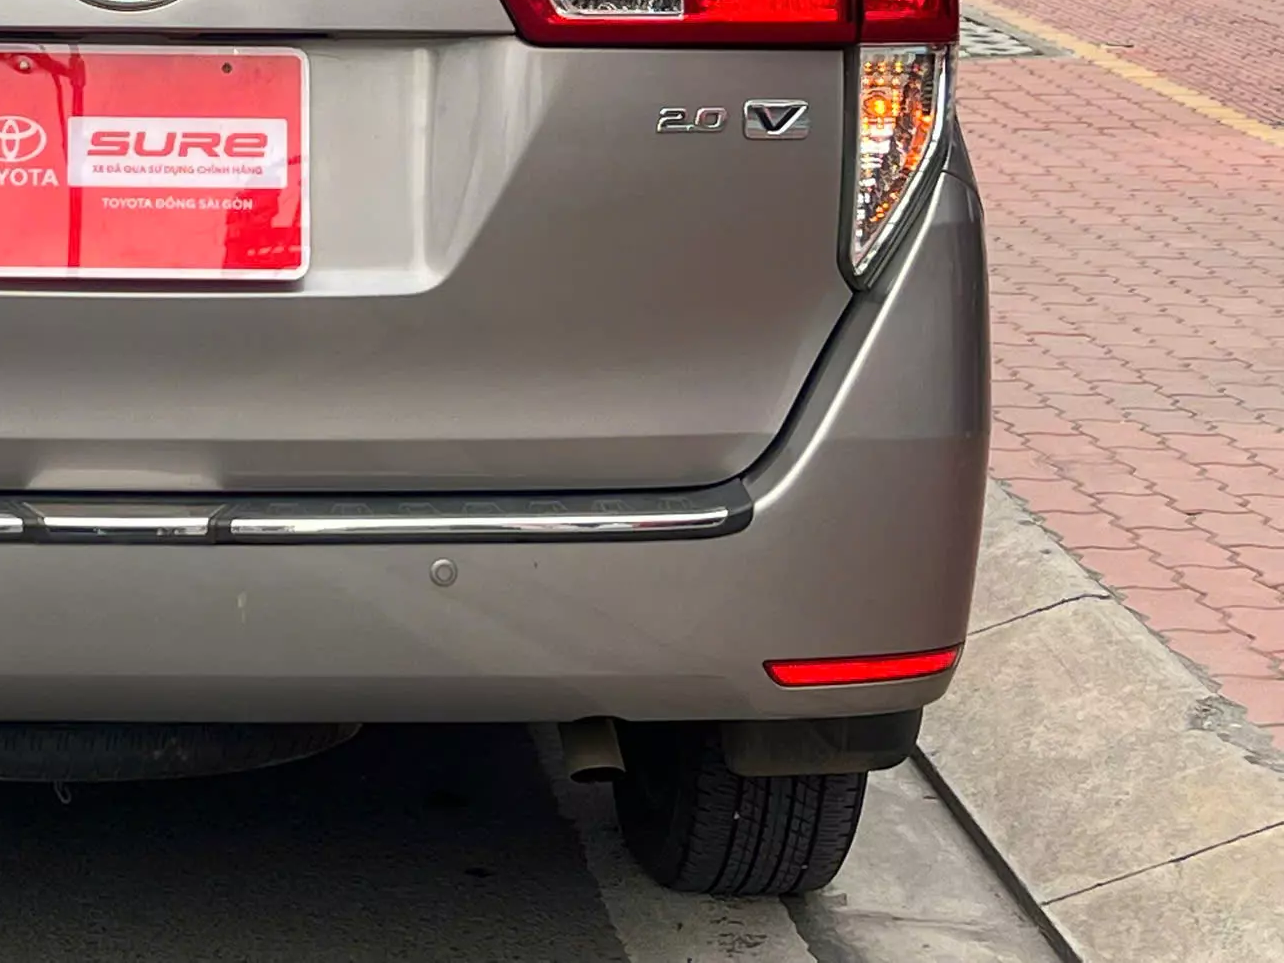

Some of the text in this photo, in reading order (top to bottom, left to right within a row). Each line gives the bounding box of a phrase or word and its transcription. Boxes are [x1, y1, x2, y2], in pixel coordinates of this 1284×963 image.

[656, 102, 809, 136] 2.0 V
[92, 164, 104, 174] XE
[124, 164, 147, 174] QUA
[196, 163, 231, 175] CHÍNH
[101, 194, 254, 210] TOYOTA ĐÔNG SÀI GÒN
